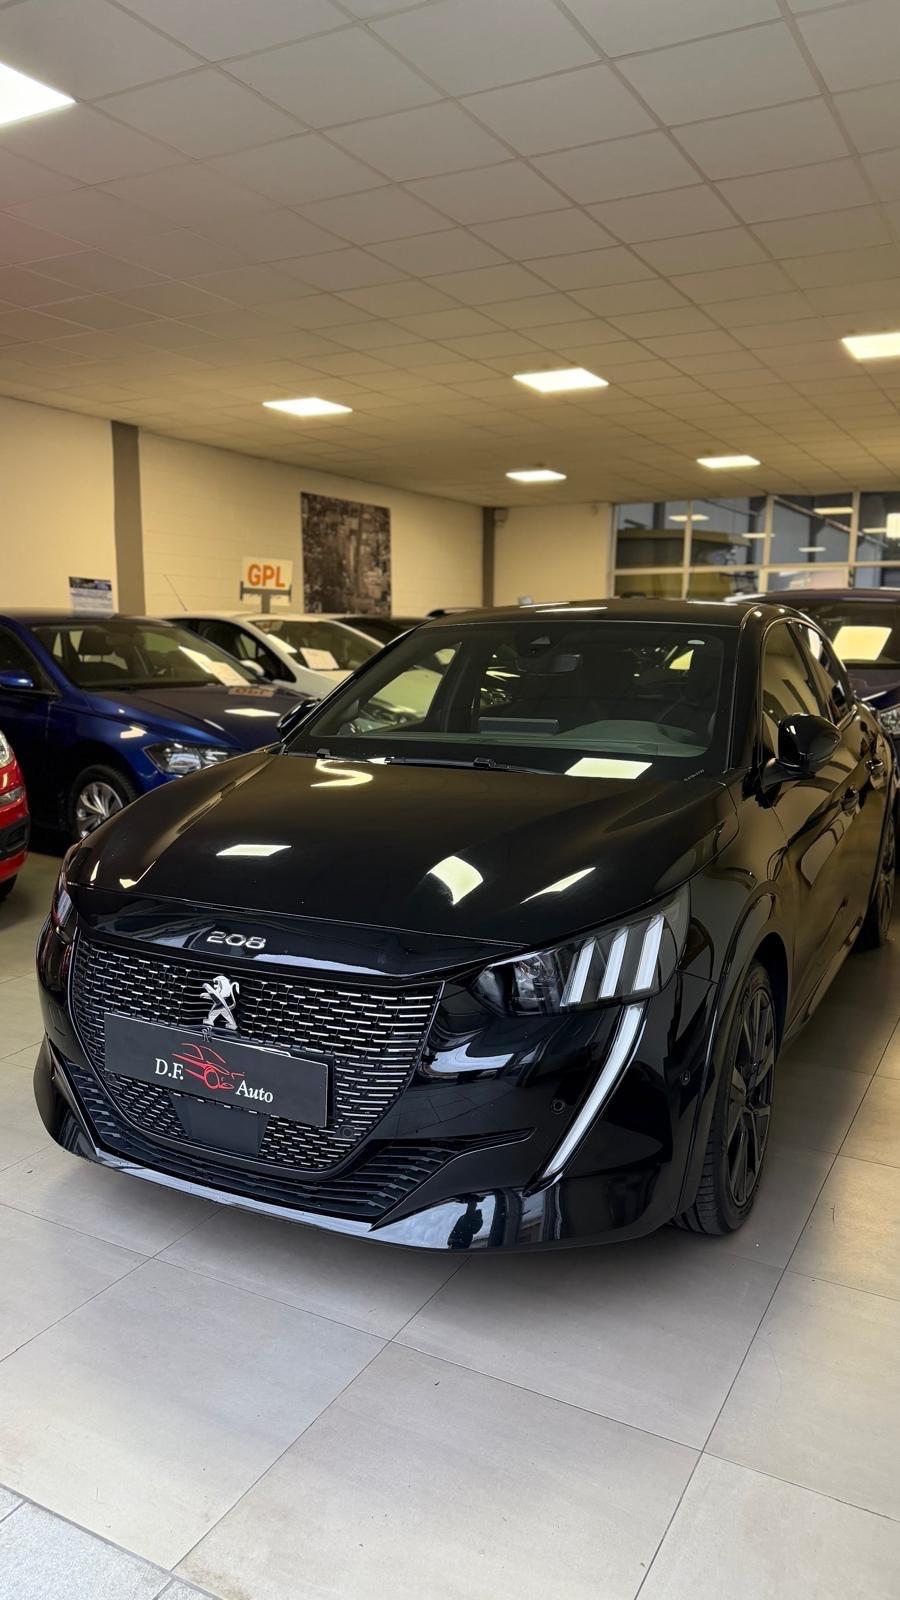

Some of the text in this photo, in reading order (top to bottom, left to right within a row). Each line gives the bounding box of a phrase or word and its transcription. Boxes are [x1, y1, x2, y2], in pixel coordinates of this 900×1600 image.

[247, 563, 286, 588] GPL
[206, 930, 267, 950] 208
[155, 1057, 274, 1104] D.F. Auto
